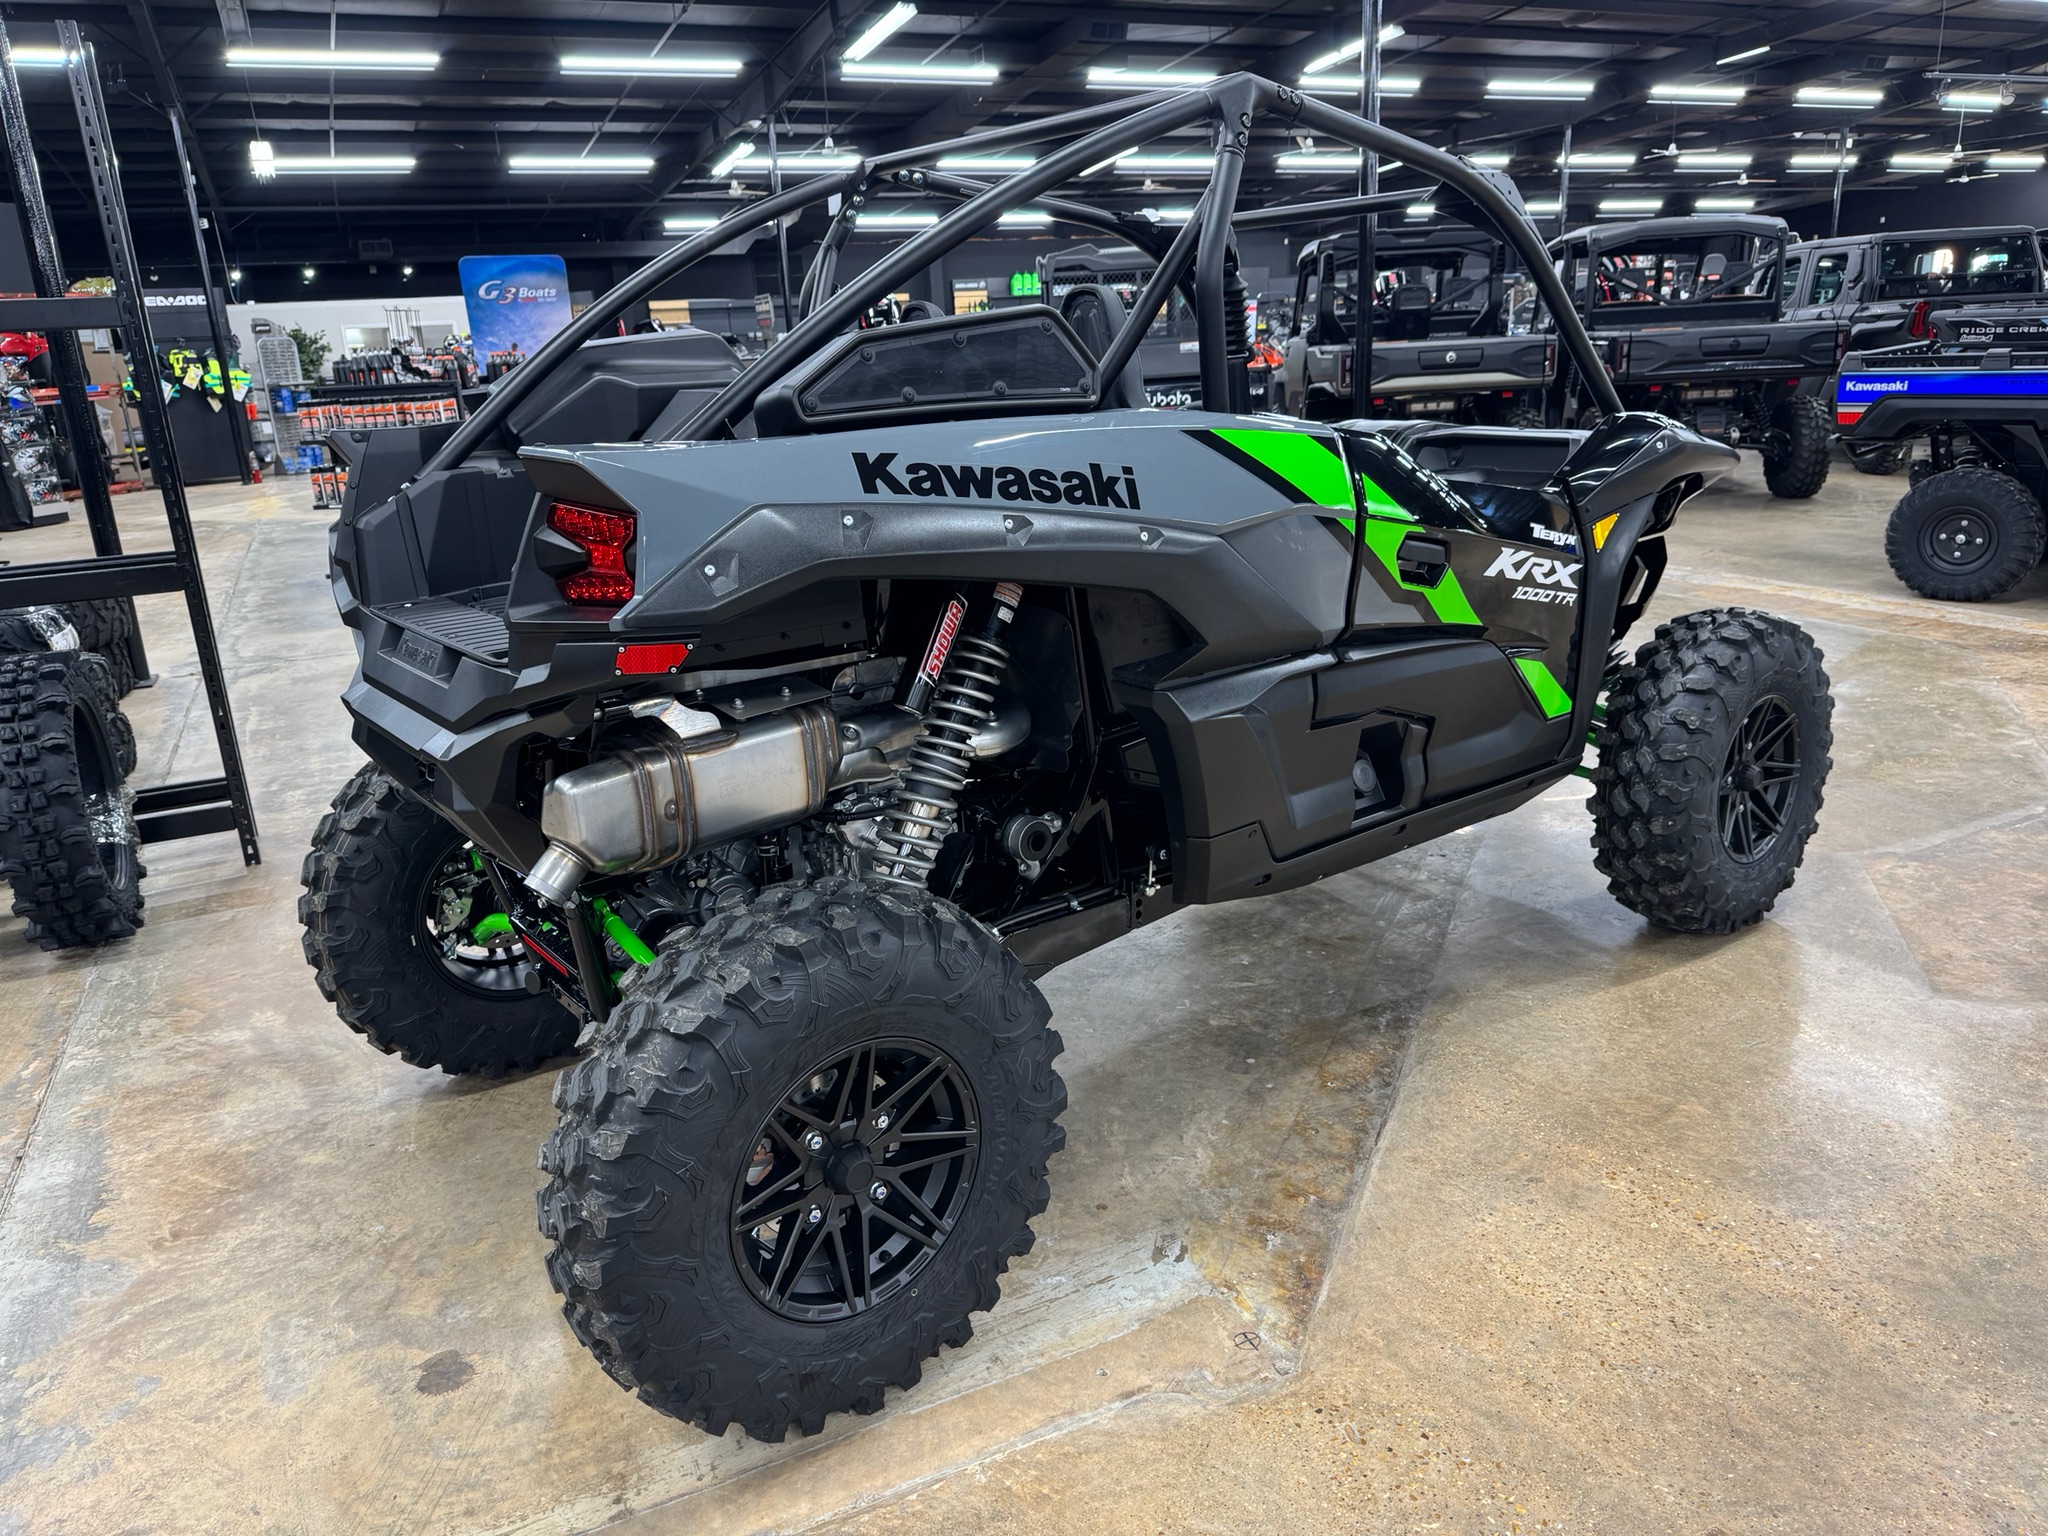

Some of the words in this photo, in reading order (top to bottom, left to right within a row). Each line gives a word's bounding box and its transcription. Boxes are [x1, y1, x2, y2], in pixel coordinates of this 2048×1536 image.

[478, 280, 517, 304] G3
[519, 287, 557, 298] Boats
[1146, 390, 1192, 406] ubota
[1846, 380, 1907, 391] Kawasaki
[851, 452, 1141, 510] Kawasaki
[1483, 547, 1583, 589] KRX
[927, 600, 963, 680] SHOWA
